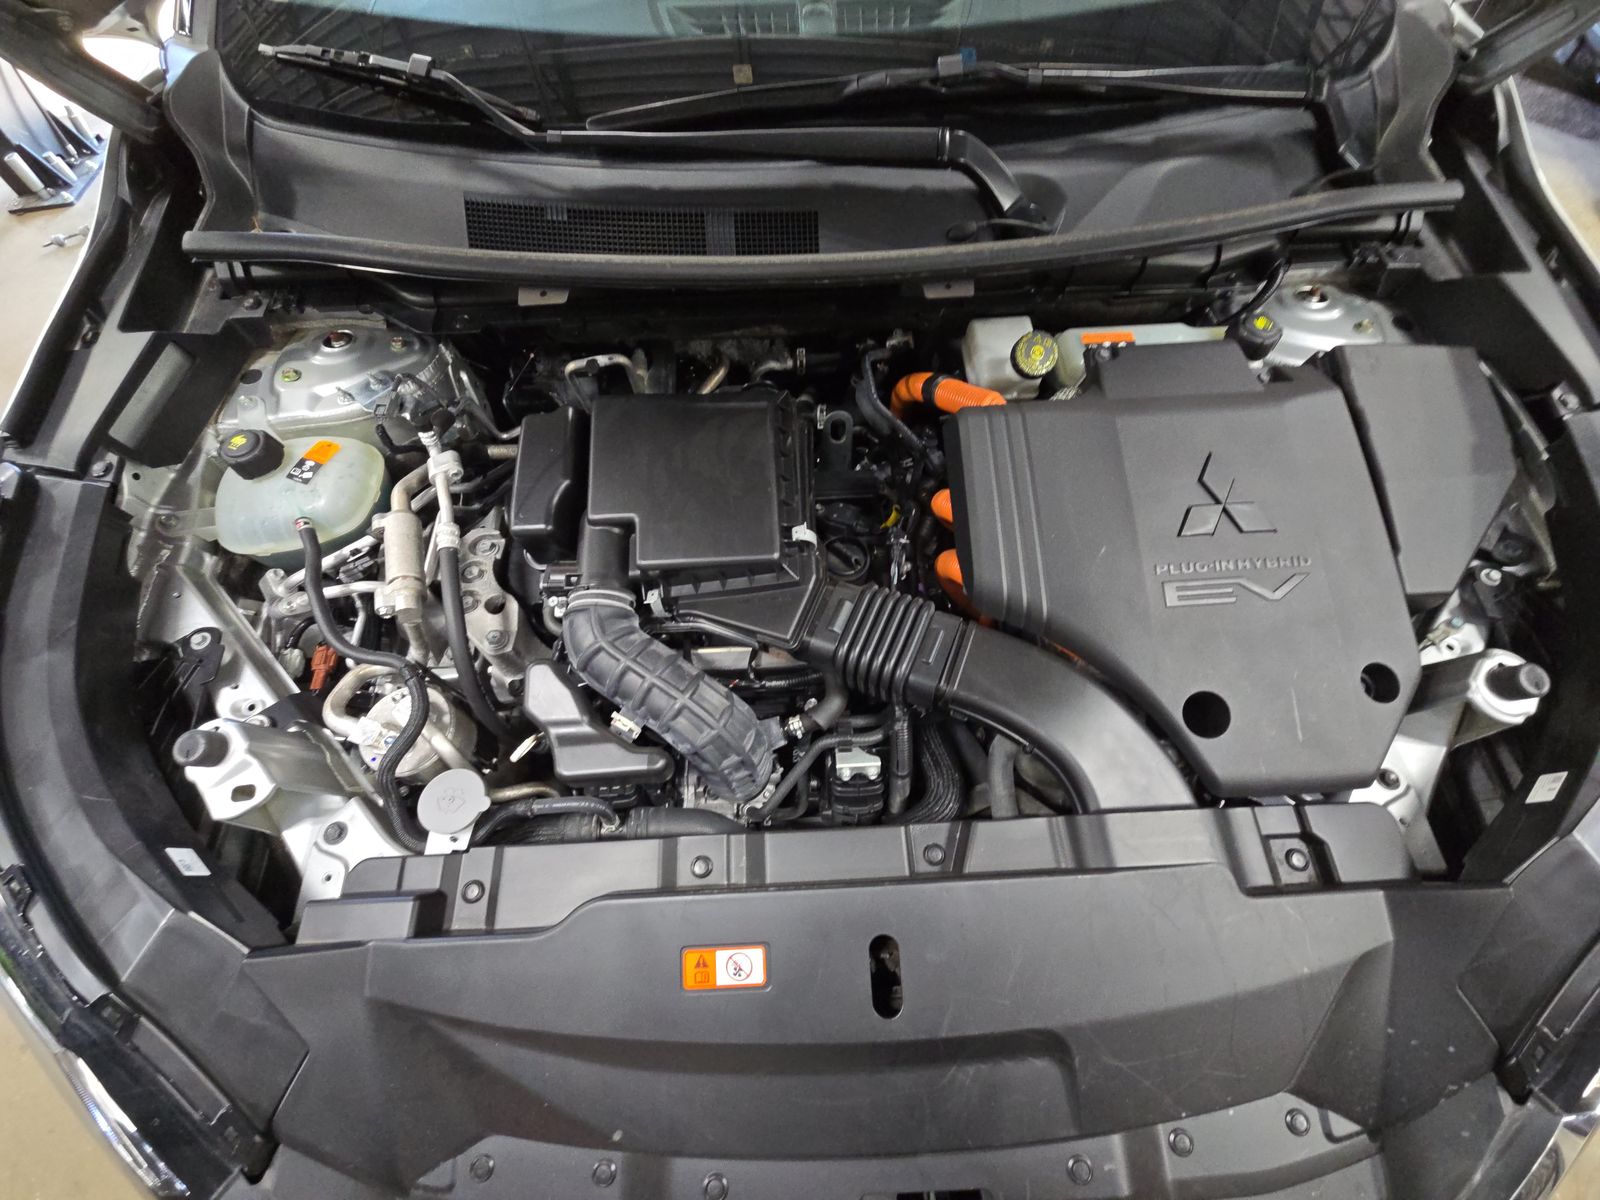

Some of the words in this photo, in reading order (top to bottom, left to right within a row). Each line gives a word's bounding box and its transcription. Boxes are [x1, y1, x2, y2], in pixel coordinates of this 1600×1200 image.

[1154, 559, 1234, 576] PLUG-IN
[1236, 555, 1312, 571] HYBRID
[1162, 572, 1310, 608] EV
